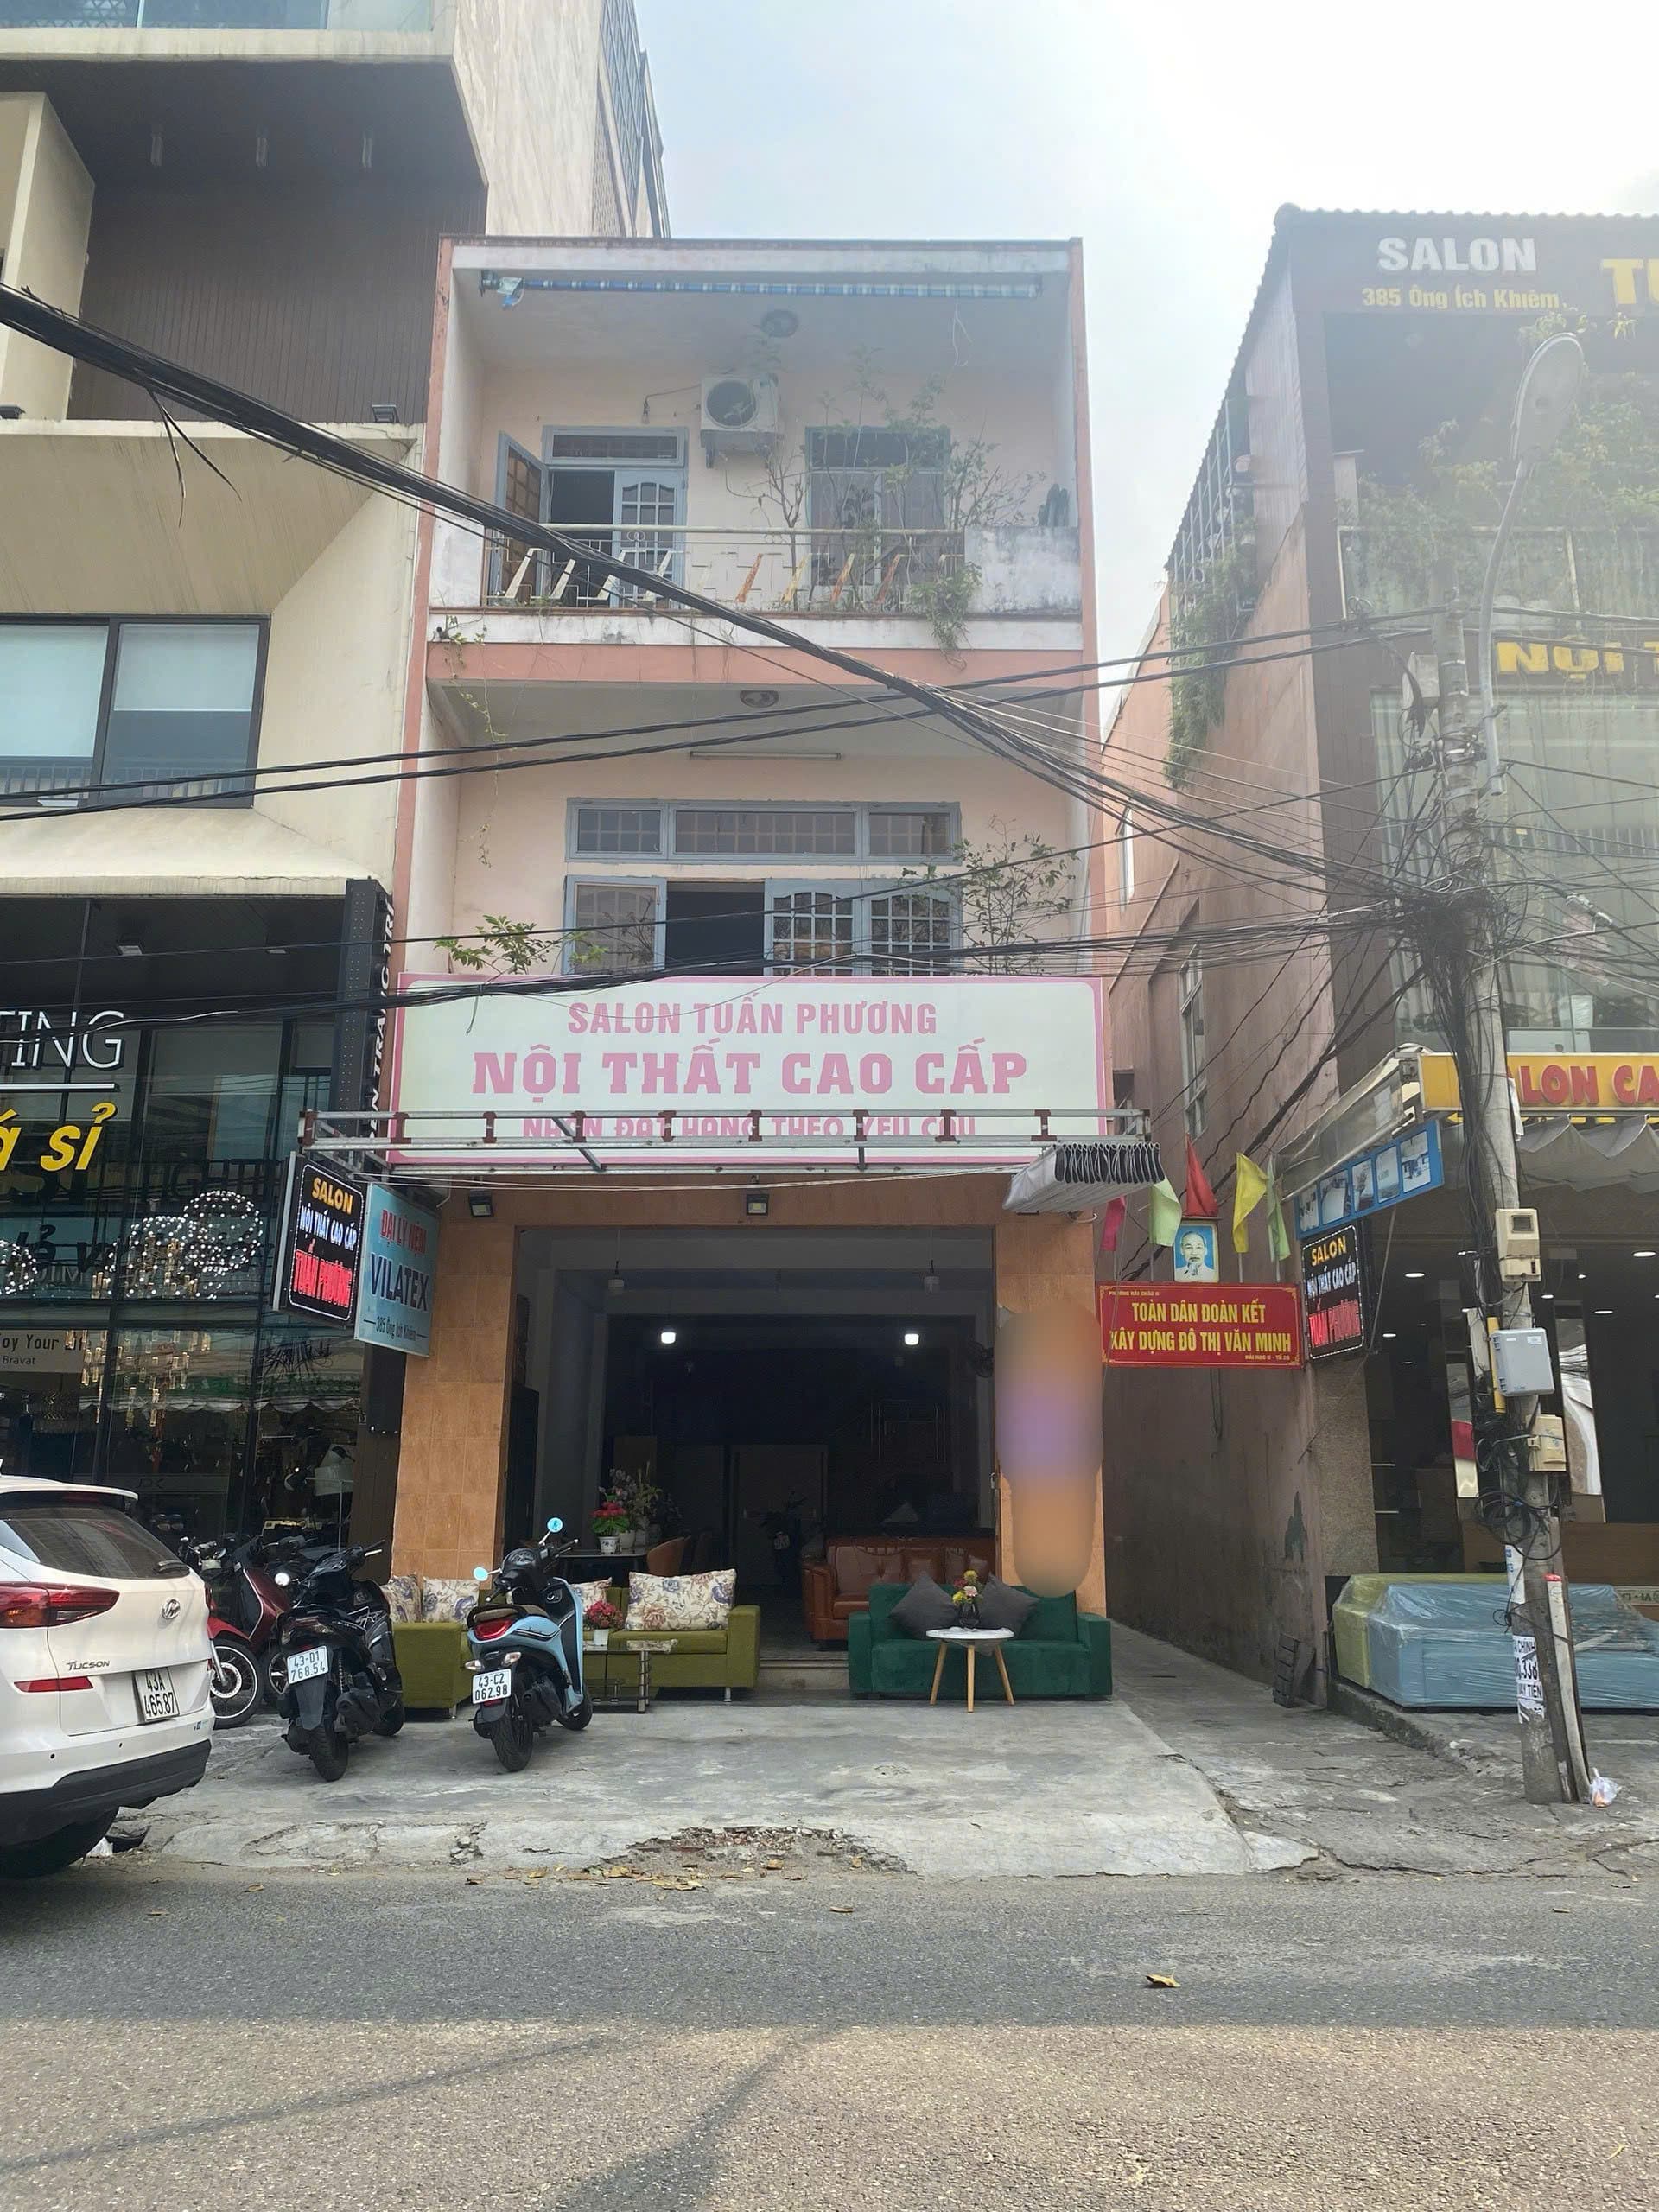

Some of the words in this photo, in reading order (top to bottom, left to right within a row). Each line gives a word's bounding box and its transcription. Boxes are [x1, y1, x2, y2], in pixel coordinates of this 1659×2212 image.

[1377, 238, 1536, 270] SALON
[1363, 288, 1400, 307] 385
[1409, 284, 1447, 309] Ông
[1456, 284, 1486, 308] Ích
[1493, 288, 1560, 308] Khiêm
[568, 1002, 680, 1034] SALON
[694, 992, 782, 1034] TUẤN
[796, 1000, 936, 1034] PHƯƠNG
[472, 1043, 581, 1103] NỘI
[601, 1037, 760, 1094] THẤT
[781, 1052, 893, 1094] CAO
[915, 1037, 1027, 1094] CẤP
[1506, 1065, 1599, 1105] LON
[40, 1102, 118, 1172] sỉ
[312, 1177, 353, 1215] SALON
[299, 1203, 314, 1238] NỘI
[331, 1218, 344, 1247] CAO
[345, 1222, 358, 1252] CẤP
[1312, 1235, 1347, 1267] SALON
[370, 1251, 429, 1312] VILATEX
[1132, 1299, 1166, 1323] TOÀN
[1171, 1300, 1197, 1323] DÂN
[1201, 1299, 1238, 1324] ĐOÀN
[1242, 1298, 1266, 1324] KẾT
[375, 1314, 386, 1334] 385
[0, 1333, 18, 1353] oy
[27, 1333, 59, 1350] Your
[1109, 1327, 1135, 1350] XÂY
[1139, 1328, 1175, 1354] DỰNG
[1179, 1328, 1196, 1351] ĐÔ
[1200, 1332, 1221, 1356] THỊ
[1224, 1329, 1251, 1352] VĂN
[1255, 1332, 1291, 1353] MINH
[3, 1356, 35, 1365] Bravat
[67, 1660, 110, 1671] TUCSON
[290, 1661, 327, 1682] 768.54
[292, 1649, 321, 1669] 43-D1
[146, 1670, 166, 1691] 43A
[478, 1671, 505, 1689] 43-C2
[143, 1692, 175, 1717] 465.87
[474, 1684, 510, 1703] 062.98
